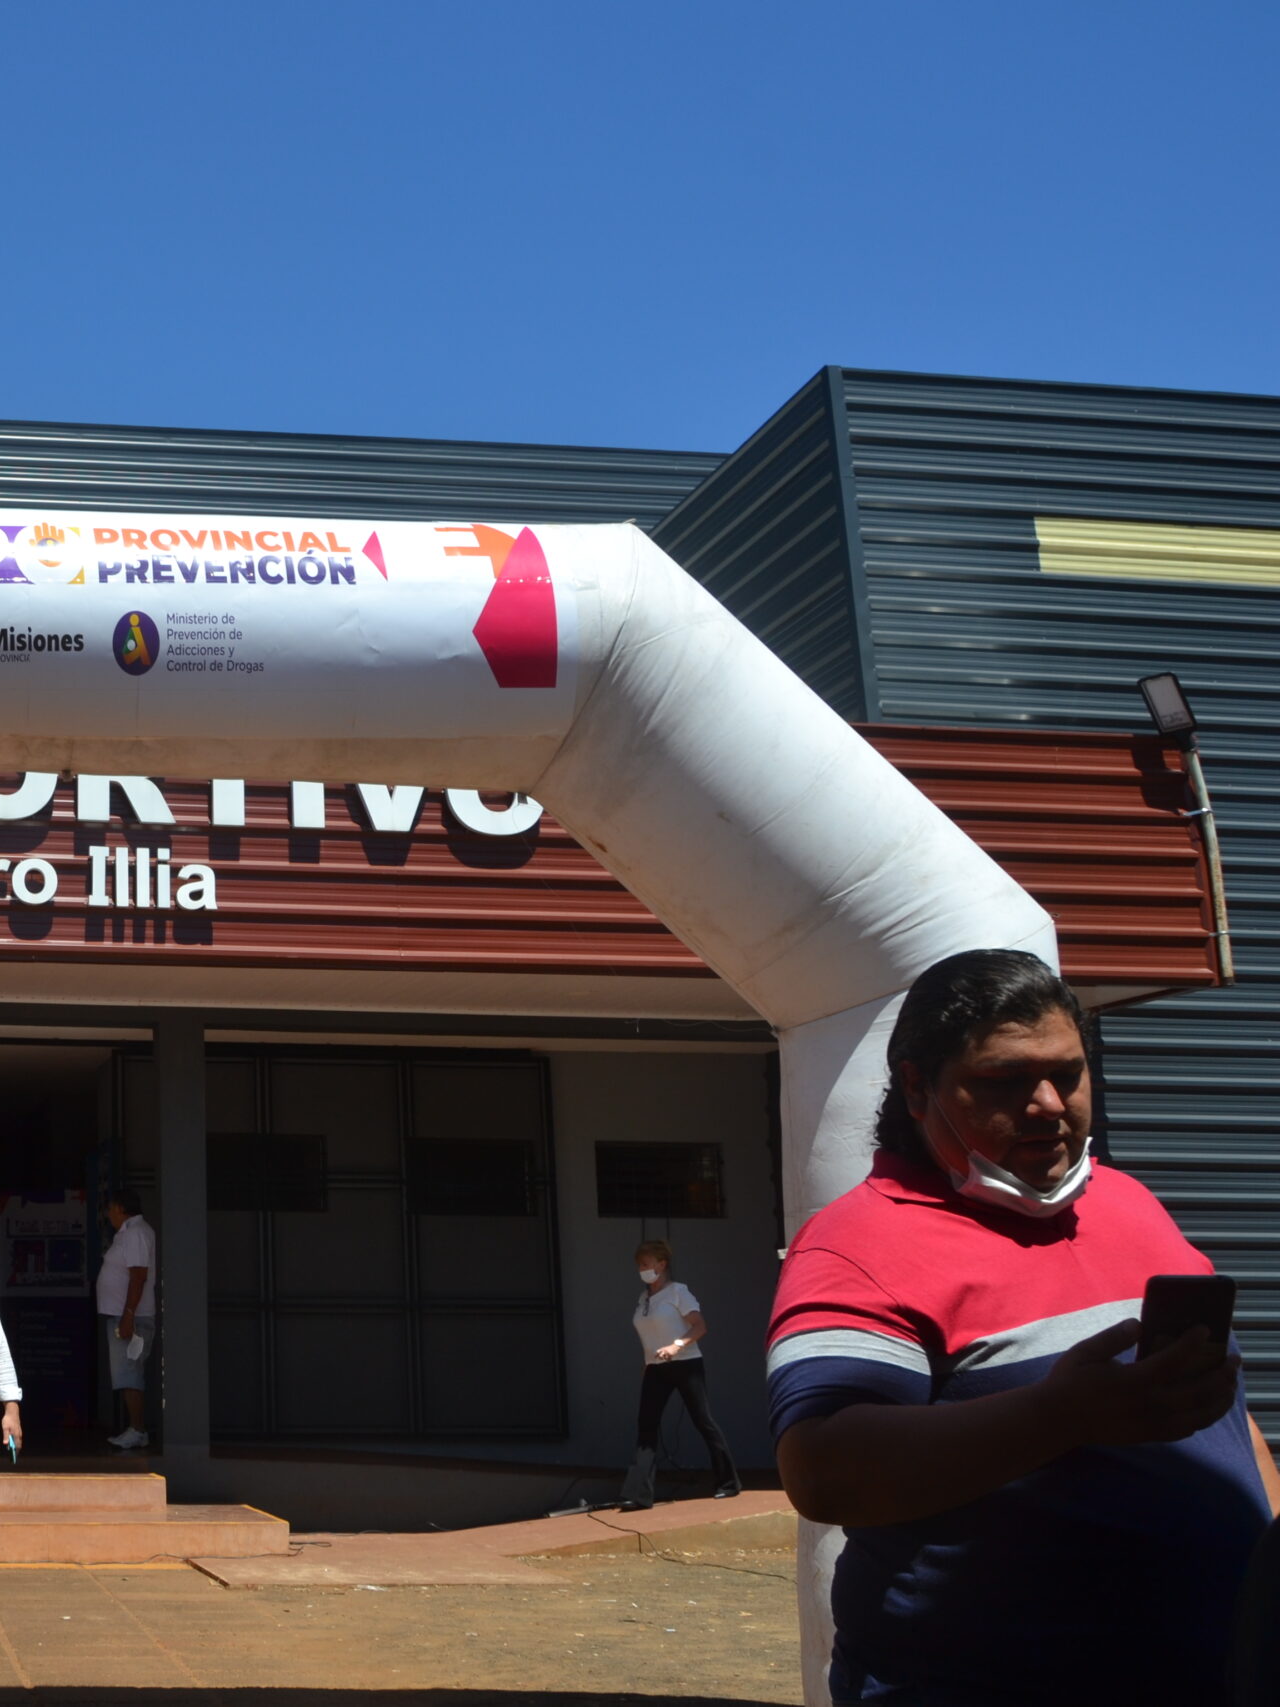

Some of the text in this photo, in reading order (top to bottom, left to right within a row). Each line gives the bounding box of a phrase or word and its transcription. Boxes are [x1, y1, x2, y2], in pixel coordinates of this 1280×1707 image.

[93, 527, 352, 554] PROVINCIAL
[97, 549, 357, 586] PREVENCIÓN
[166, 613, 236, 625] Ministerio de
[166, 628, 243, 641] Prevención de
[166, 644, 235, 658] Adicciones y
[166, 660, 265, 675] Control de Drogas
[88, 845, 219, 911] Illia
